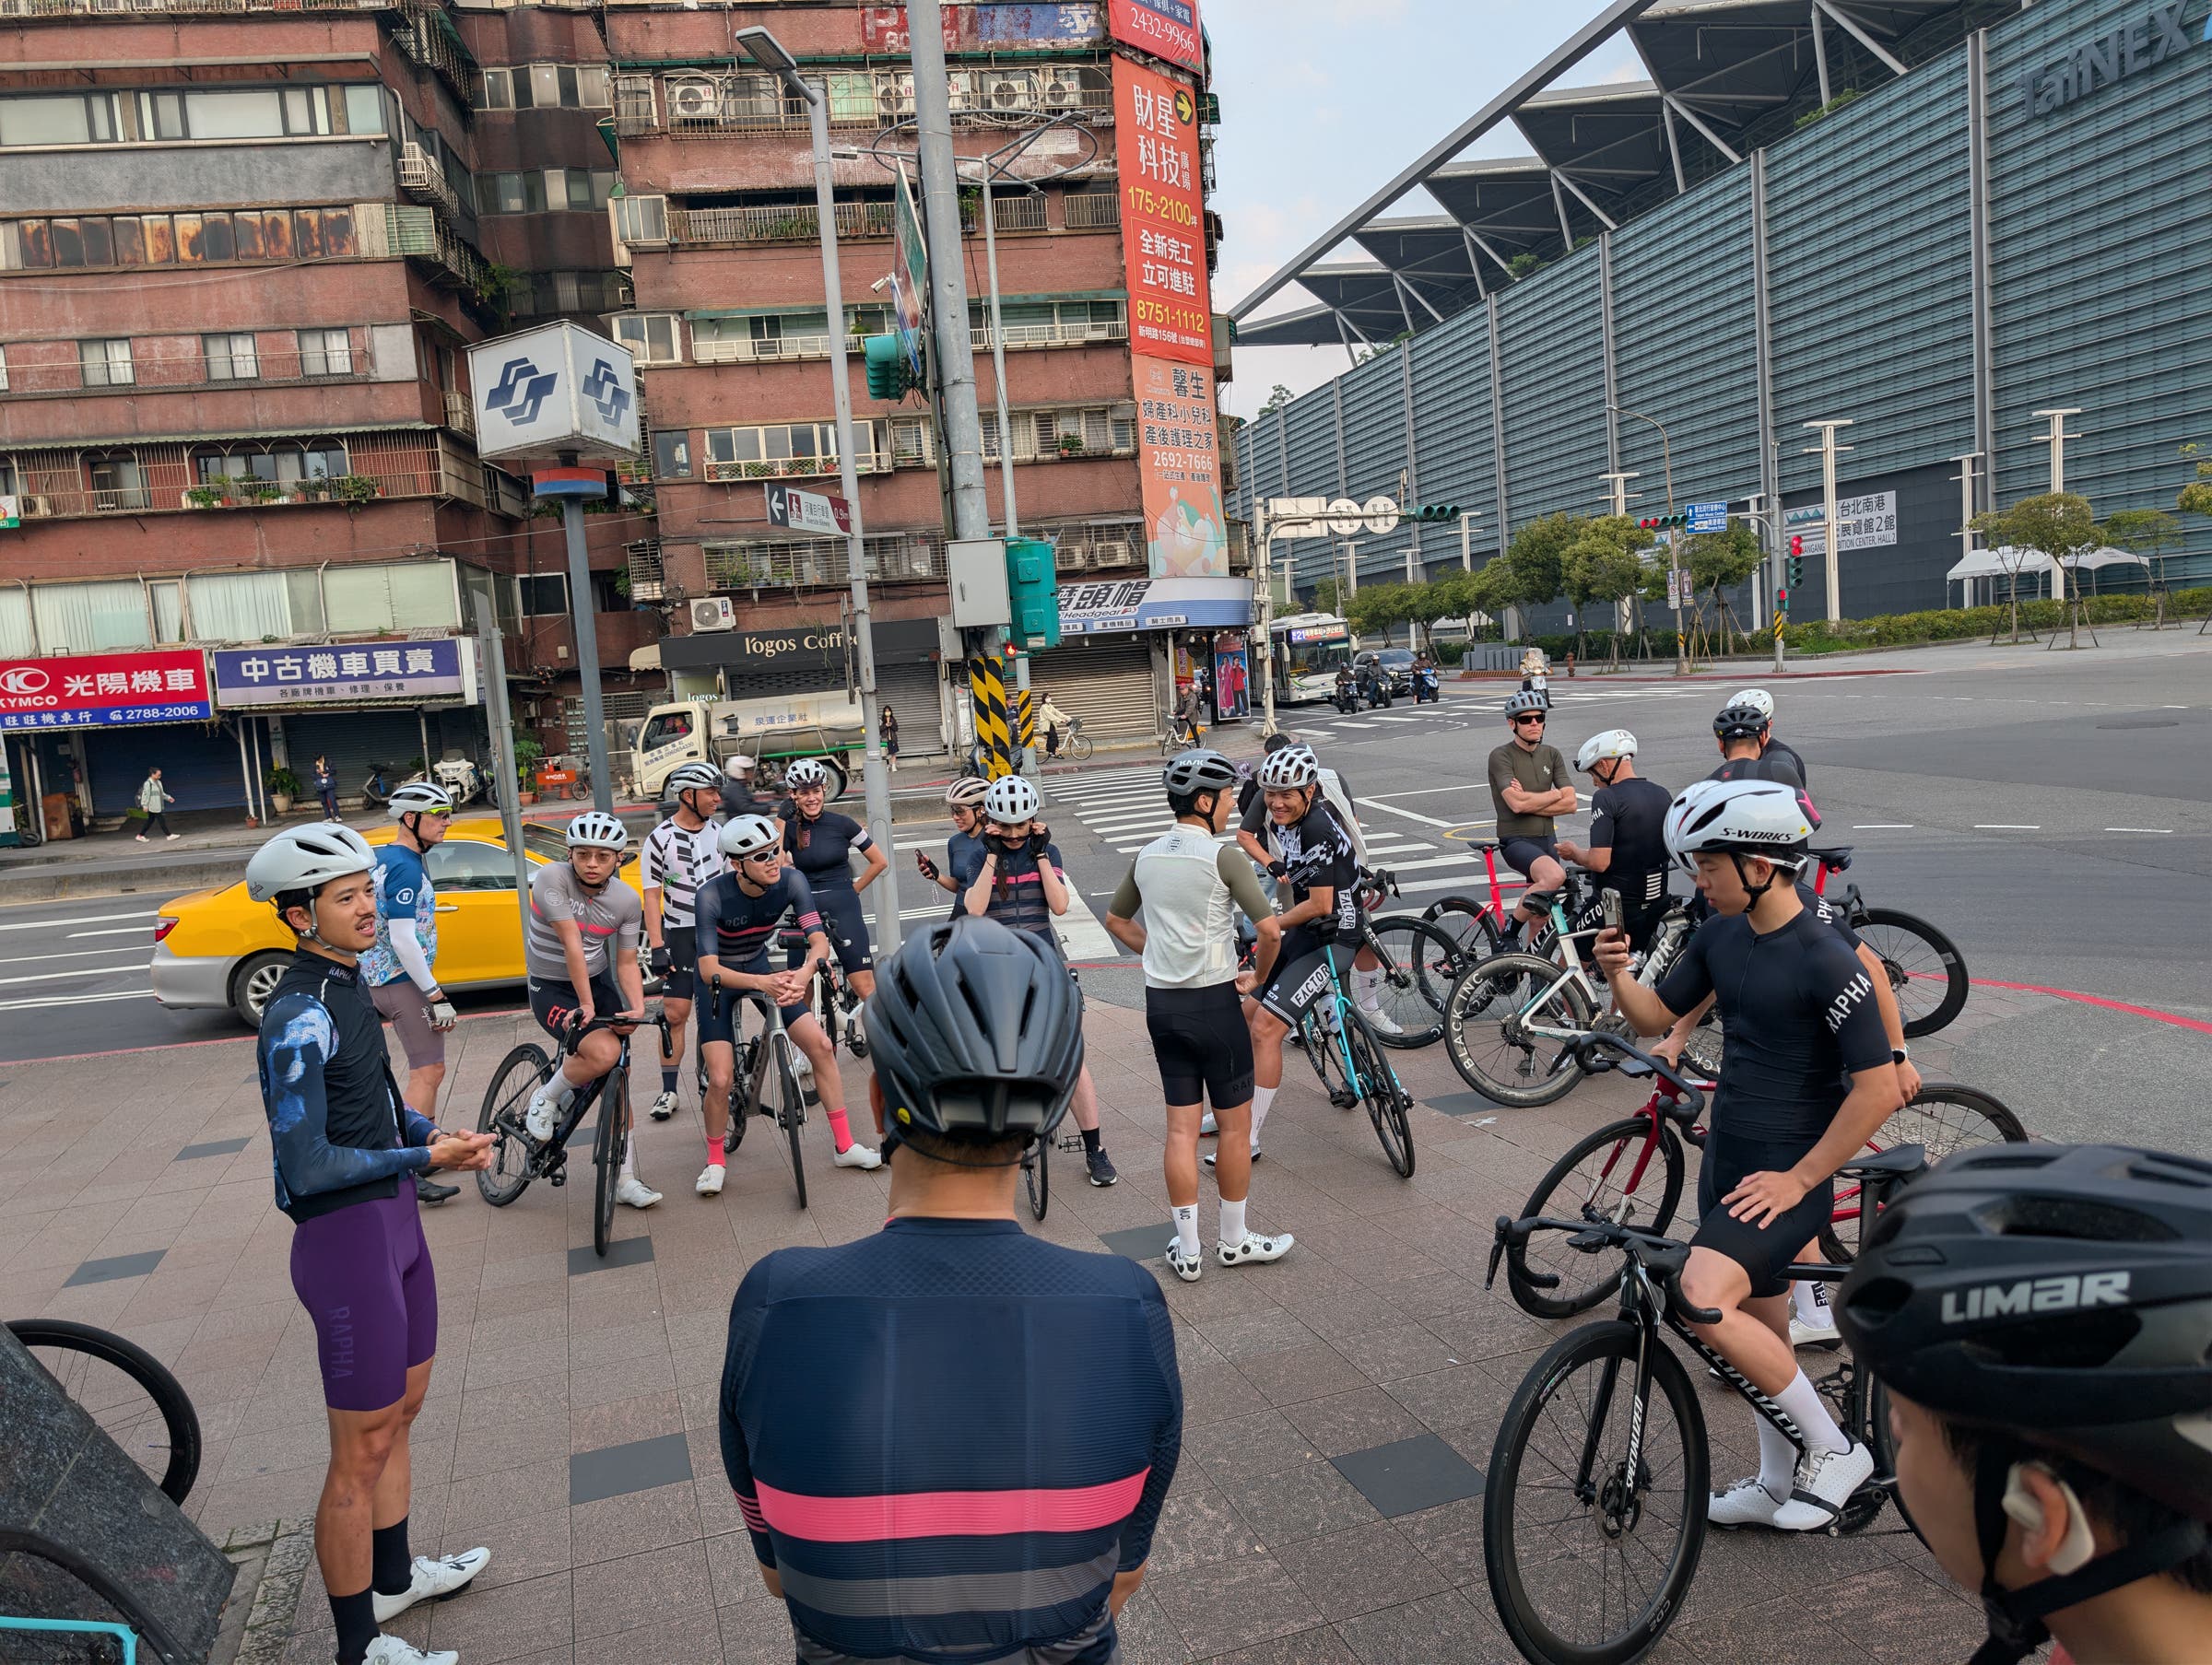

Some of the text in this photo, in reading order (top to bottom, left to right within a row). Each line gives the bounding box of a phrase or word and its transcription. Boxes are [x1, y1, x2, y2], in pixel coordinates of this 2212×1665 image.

[1130, 7, 1194, 53] 2432-9966
[2015, 0, 2192, 120] TaiNEX
[1133, 84, 1177, 140] 財星
[1137, 134, 1181, 187] 科技
[1140, 229, 1194, 266] 全新完工
[1142, 260, 1195, 296] 立可進駐
[1136, 299, 1206, 333] 8751-1112
[1171, 368, 1206, 401] 馨生
[1142, 398, 1213, 427] 婦產科小兒科
[1145, 424, 1214, 451] 產後護理之家
[1153, 451, 1213, 471] 2692-7666
[1840, 495, 1886, 517] 台北南港
[1841, 514, 1895, 537] 展覽館2館
[1877, 534, 1891, 543] HALL
[1891, 533, 1896, 542] 2
[1064, 608, 1122, 620] Headgear
[1296, 630, 1305, 640] 21
[241, 648, 436, 683] 中古機車買賣
[64, 668, 196, 698] 光陽機車
[4, 710, 93, 726] 旺旺機車行
[126, 705, 199, 720] 2788-2006
[1719, 827, 1794, 842] S-WORKS
[1340, 891, 1356, 929] FACTOR
[1576, 898, 1605, 932] FACTO
[1293, 965, 1331, 1006] FACTOR
[1825, 972, 1872, 1034] RAPHA
[1451, 972, 1483, 1070] BLACK INC
[326, 1305, 354, 1380] RAPHA
[1626, 1394, 1644, 1494] SPECIALIZED
